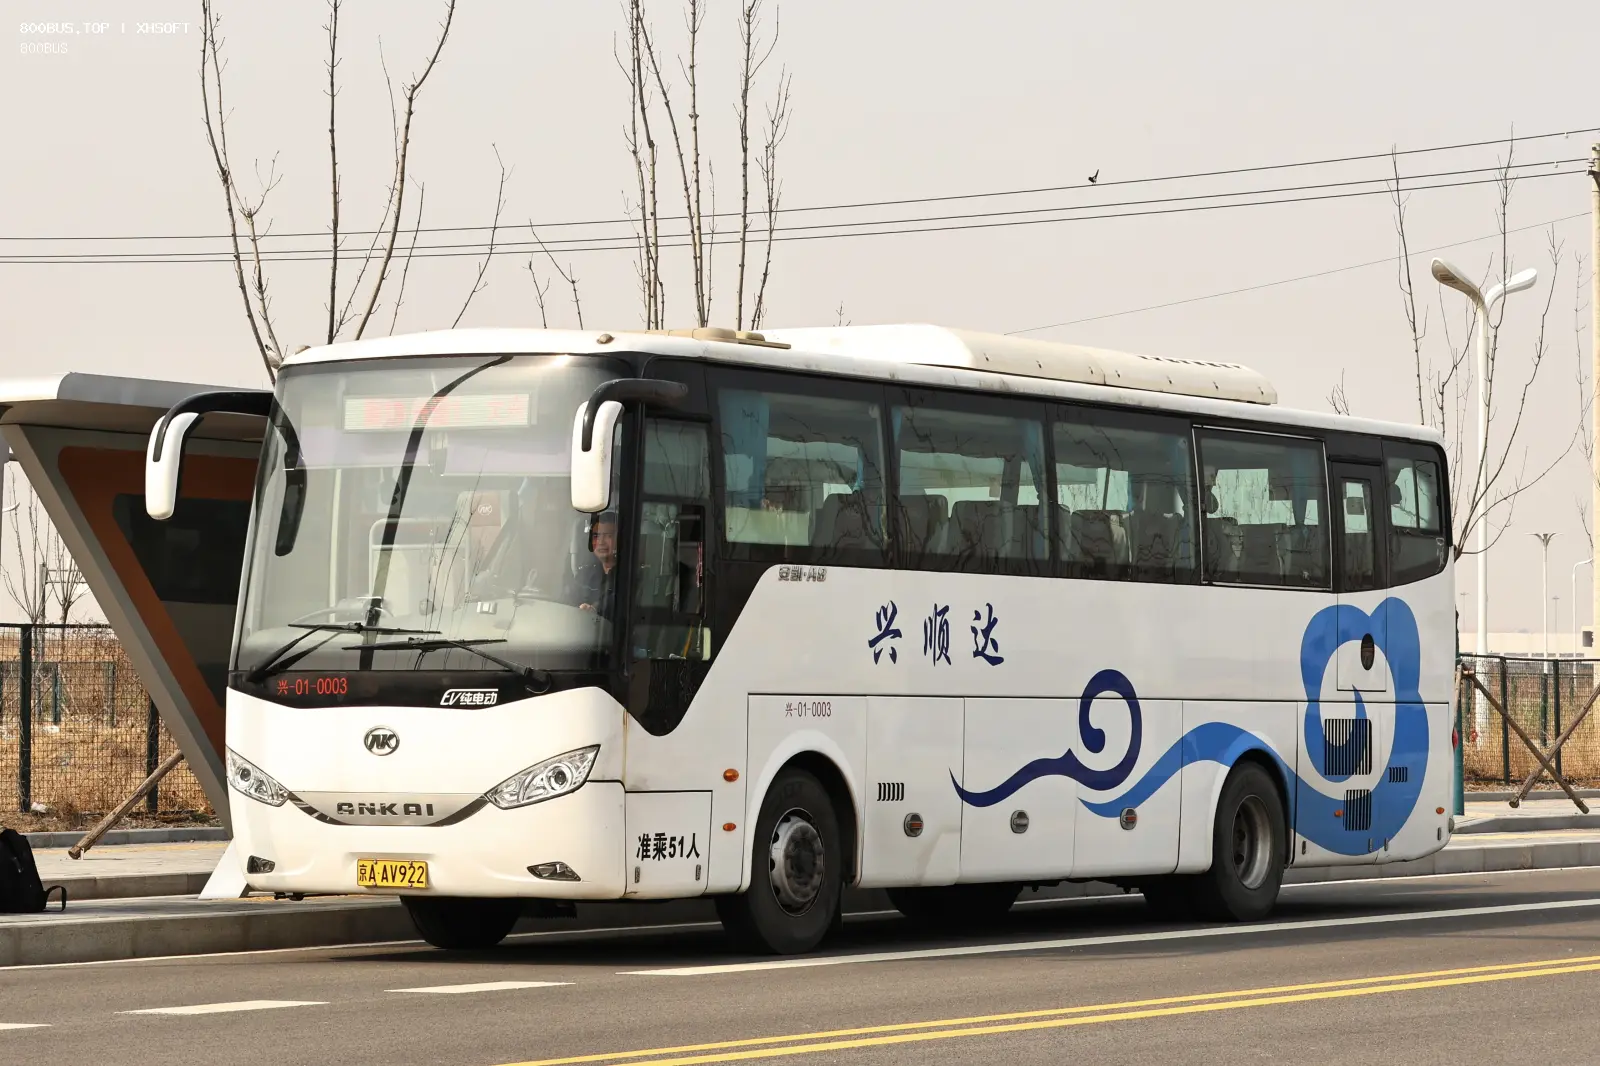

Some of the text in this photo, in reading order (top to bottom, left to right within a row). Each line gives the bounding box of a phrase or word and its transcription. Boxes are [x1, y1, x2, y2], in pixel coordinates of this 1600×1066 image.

[867, 600, 1005, 667] 兴顺达
[276, 677, 348, 696] 兴-01-0003
[785, 702, 832, 718] 兴-01-0003
[336, 802, 434, 817] ANKAI
[636, 832, 700, 861] 准乘51人
